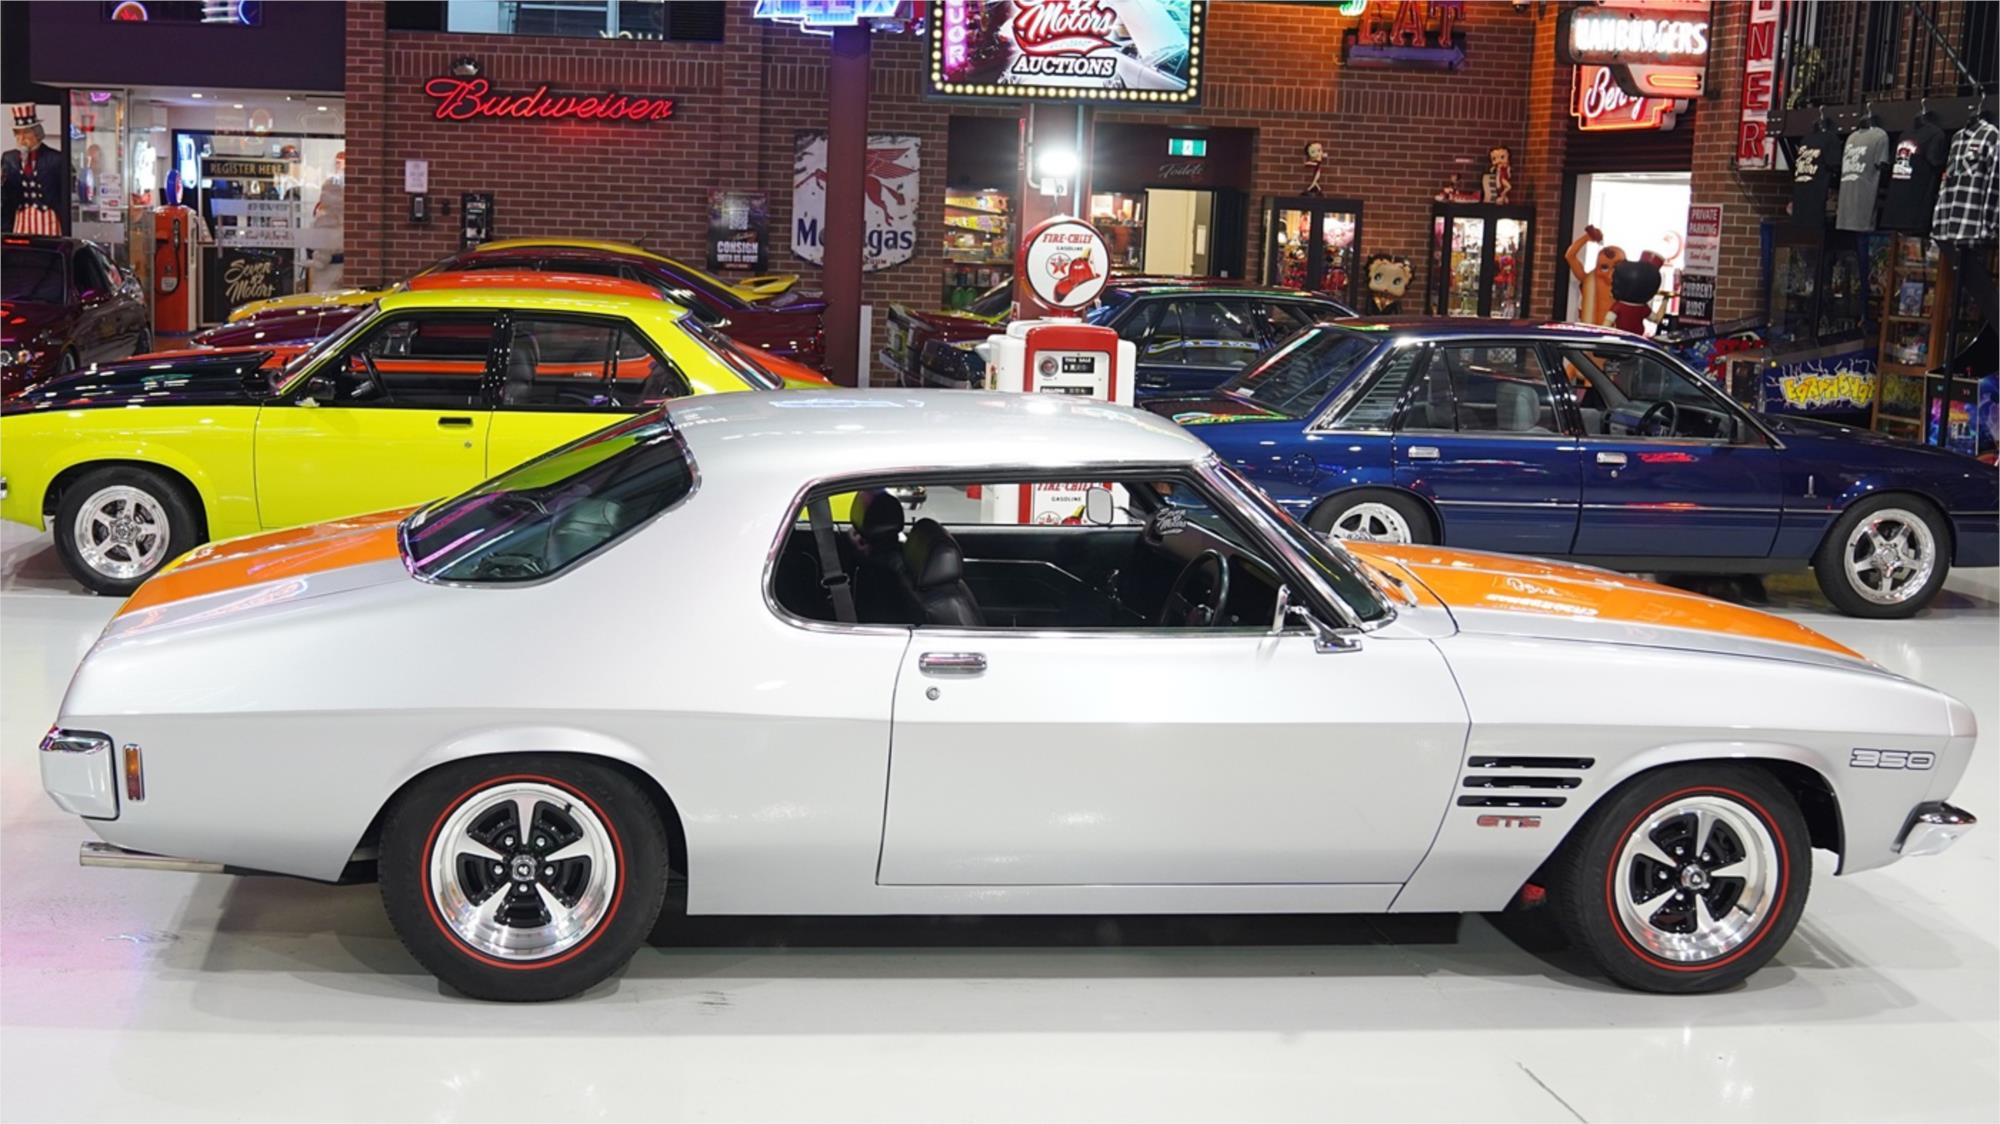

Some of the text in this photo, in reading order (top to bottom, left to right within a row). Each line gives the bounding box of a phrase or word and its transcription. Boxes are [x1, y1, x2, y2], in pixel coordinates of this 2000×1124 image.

[949, 0, 965, 65] UOR
[1015, 1, 1115, 40] Motors
[1358, 0, 1464, 48] EAT
[1574, 18, 1708, 55] HAMBURGERS
[1013, 55, 1115, 76] AUCTIONS
[1740, 0, 1776, 158] NER
[425, 78, 673, 120] Budweiser
[210, 162, 283, 174] REGISTER HERE
[1690, 208, 1719, 221] PRIVATE
[797, 218, 914, 257] Mgas
[1042, 233, 1094, 244] FIRE-CHIEF
[1688, 222, 1718, 236] PARKING
[717, 240, 758, 254] CONSIGN
[224, 258, 273, 284] Seven
[225, 280, 276, 305] Motors
[1682, 282, 1713, 300] CURRENT
[1849, 748, 1936, 771] 350
